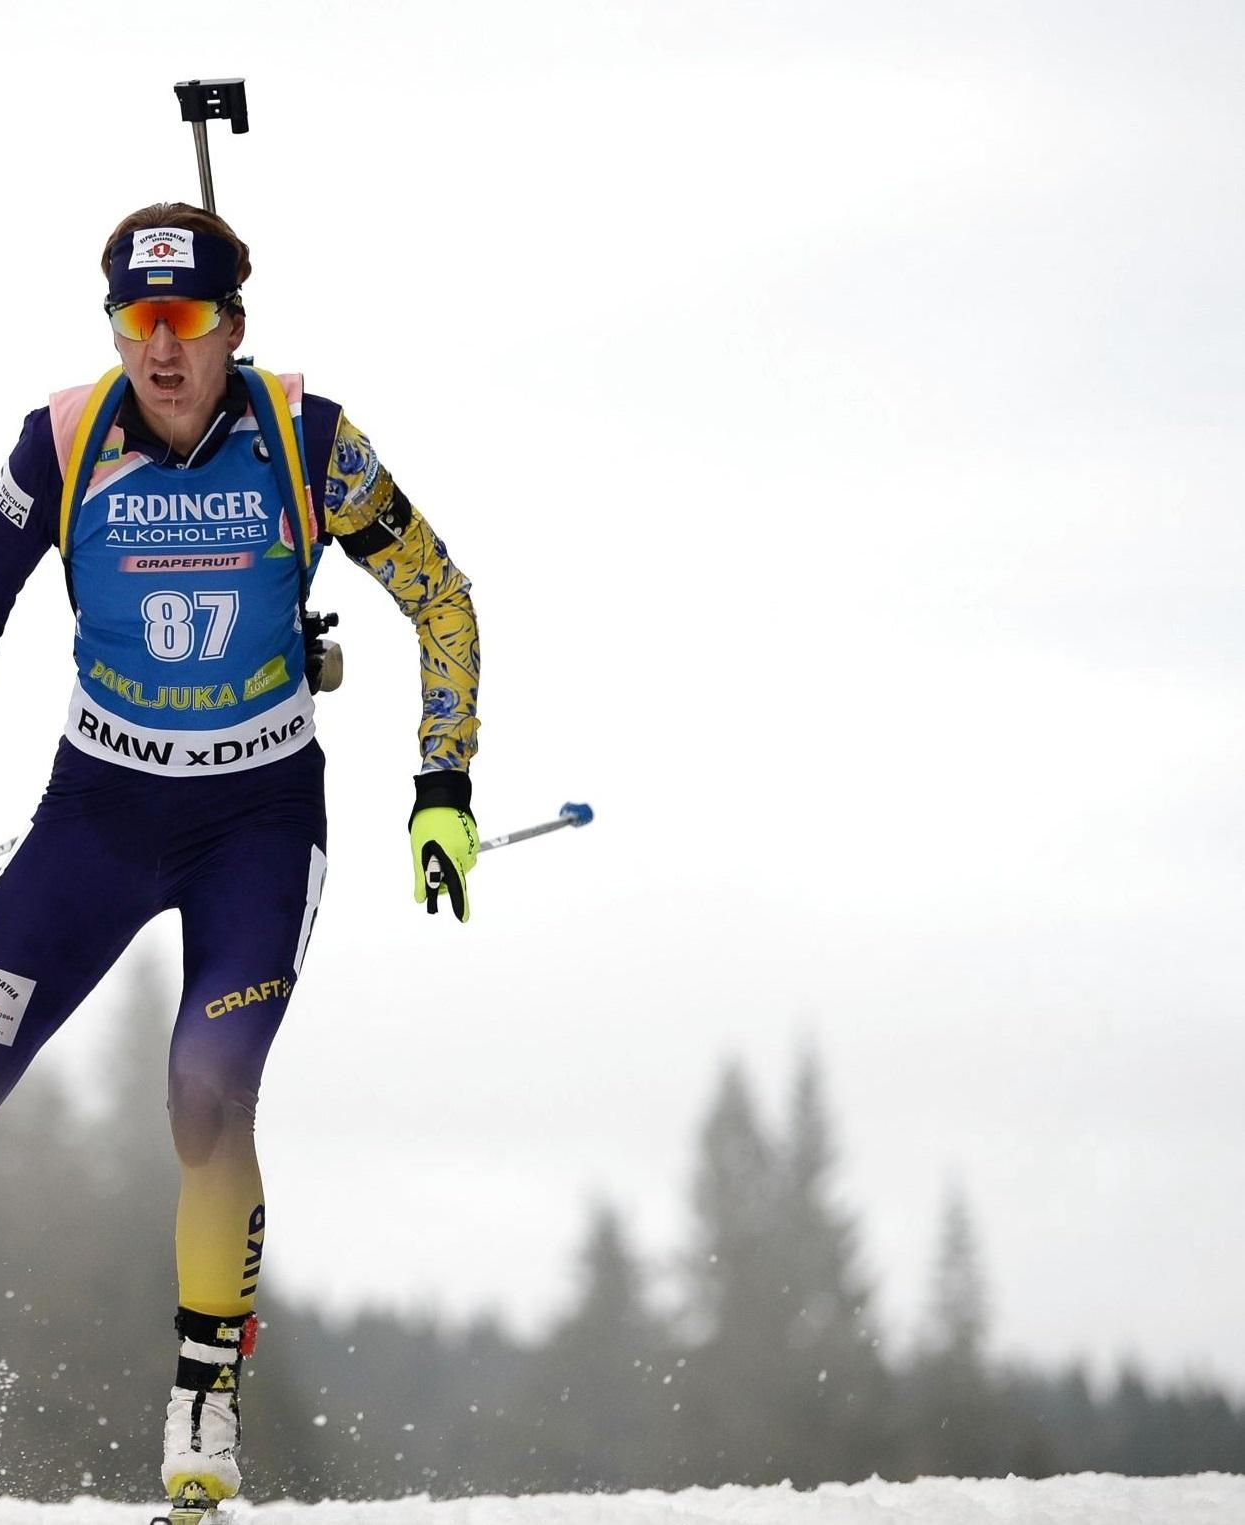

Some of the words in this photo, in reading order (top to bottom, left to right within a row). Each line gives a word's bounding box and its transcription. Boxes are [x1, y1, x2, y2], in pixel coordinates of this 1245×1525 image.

[106, 491, 270, 526] ERDINGER
[106, 524, 267, 543] ALKOHOLFREI
[135, 556, 241, 570] GRAPEFRUIT
[140, 590, 240, 663] 87
[89, 659, 239, 711] POKLJUKA
[77, 707, 175, 767] BMW
[185, 713, 306, 767] xDrive
[205, 978, 282, 1020] CRAFT
